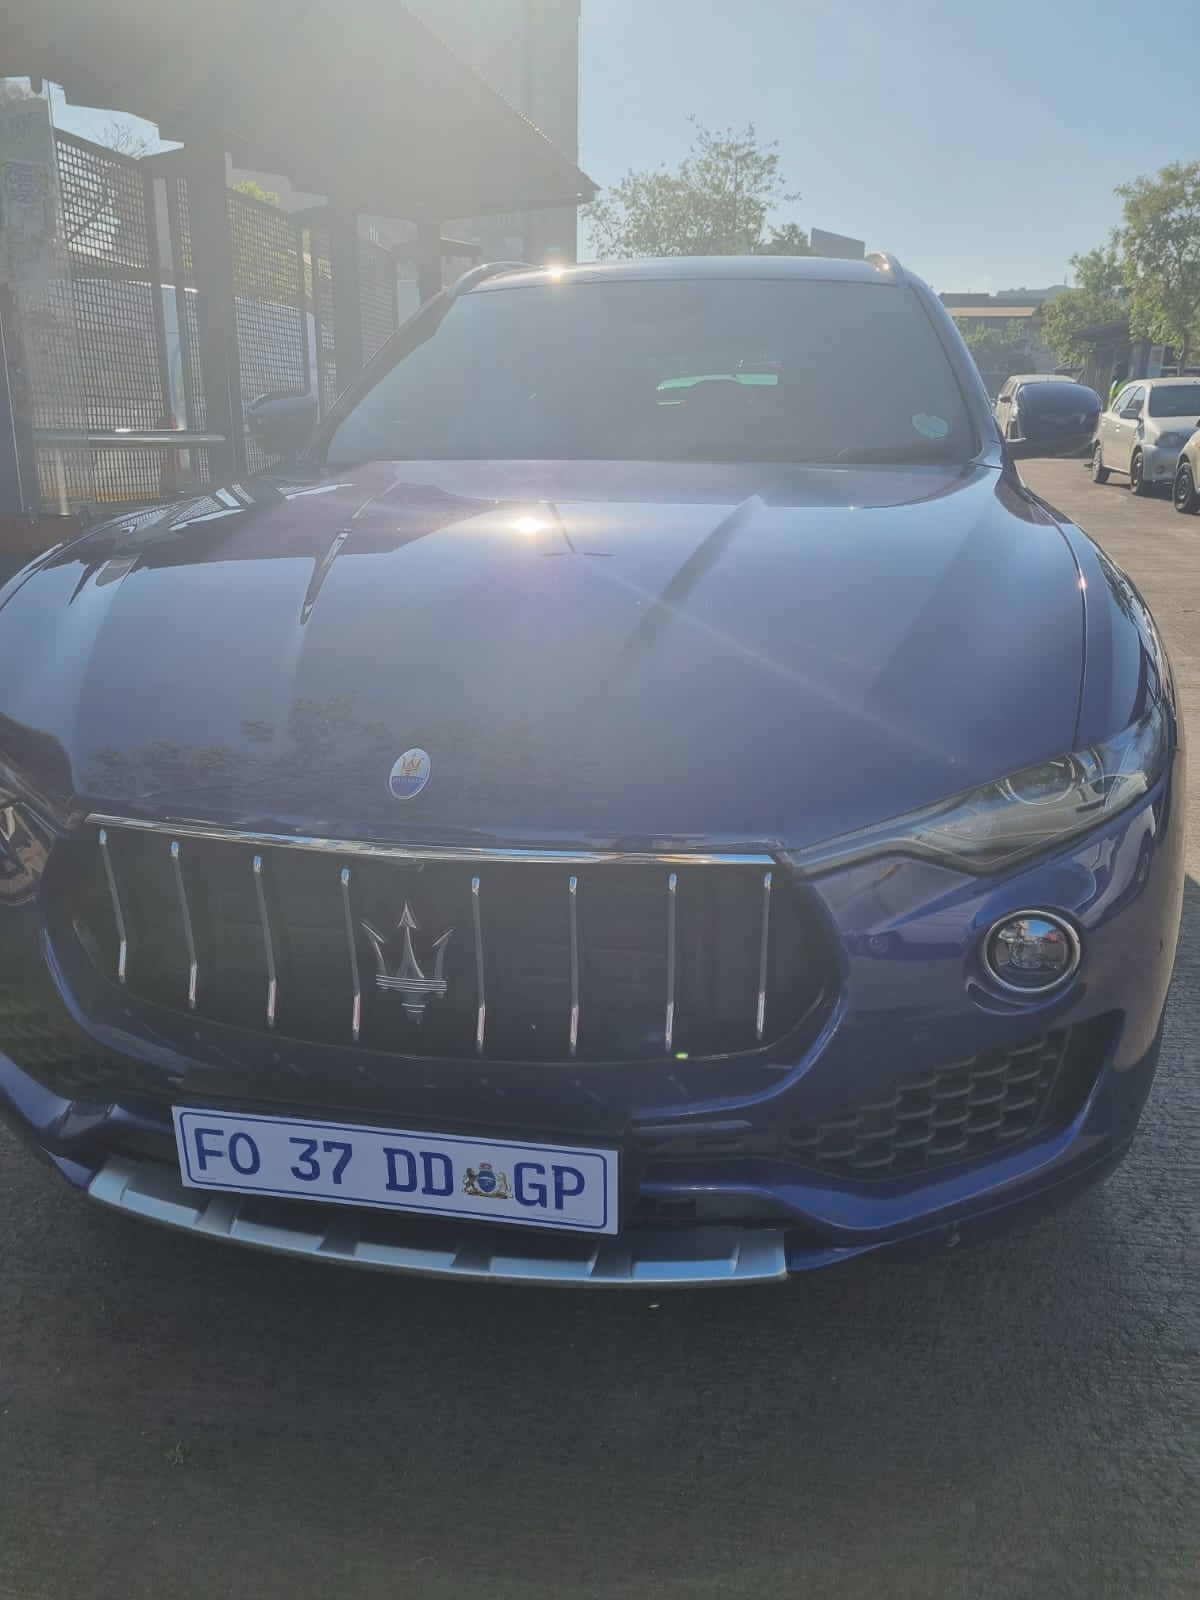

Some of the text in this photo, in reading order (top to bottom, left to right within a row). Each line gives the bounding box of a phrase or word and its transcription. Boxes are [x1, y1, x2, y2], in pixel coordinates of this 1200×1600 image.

[194, 1128, 585, 1210] FO 37 DD GP
